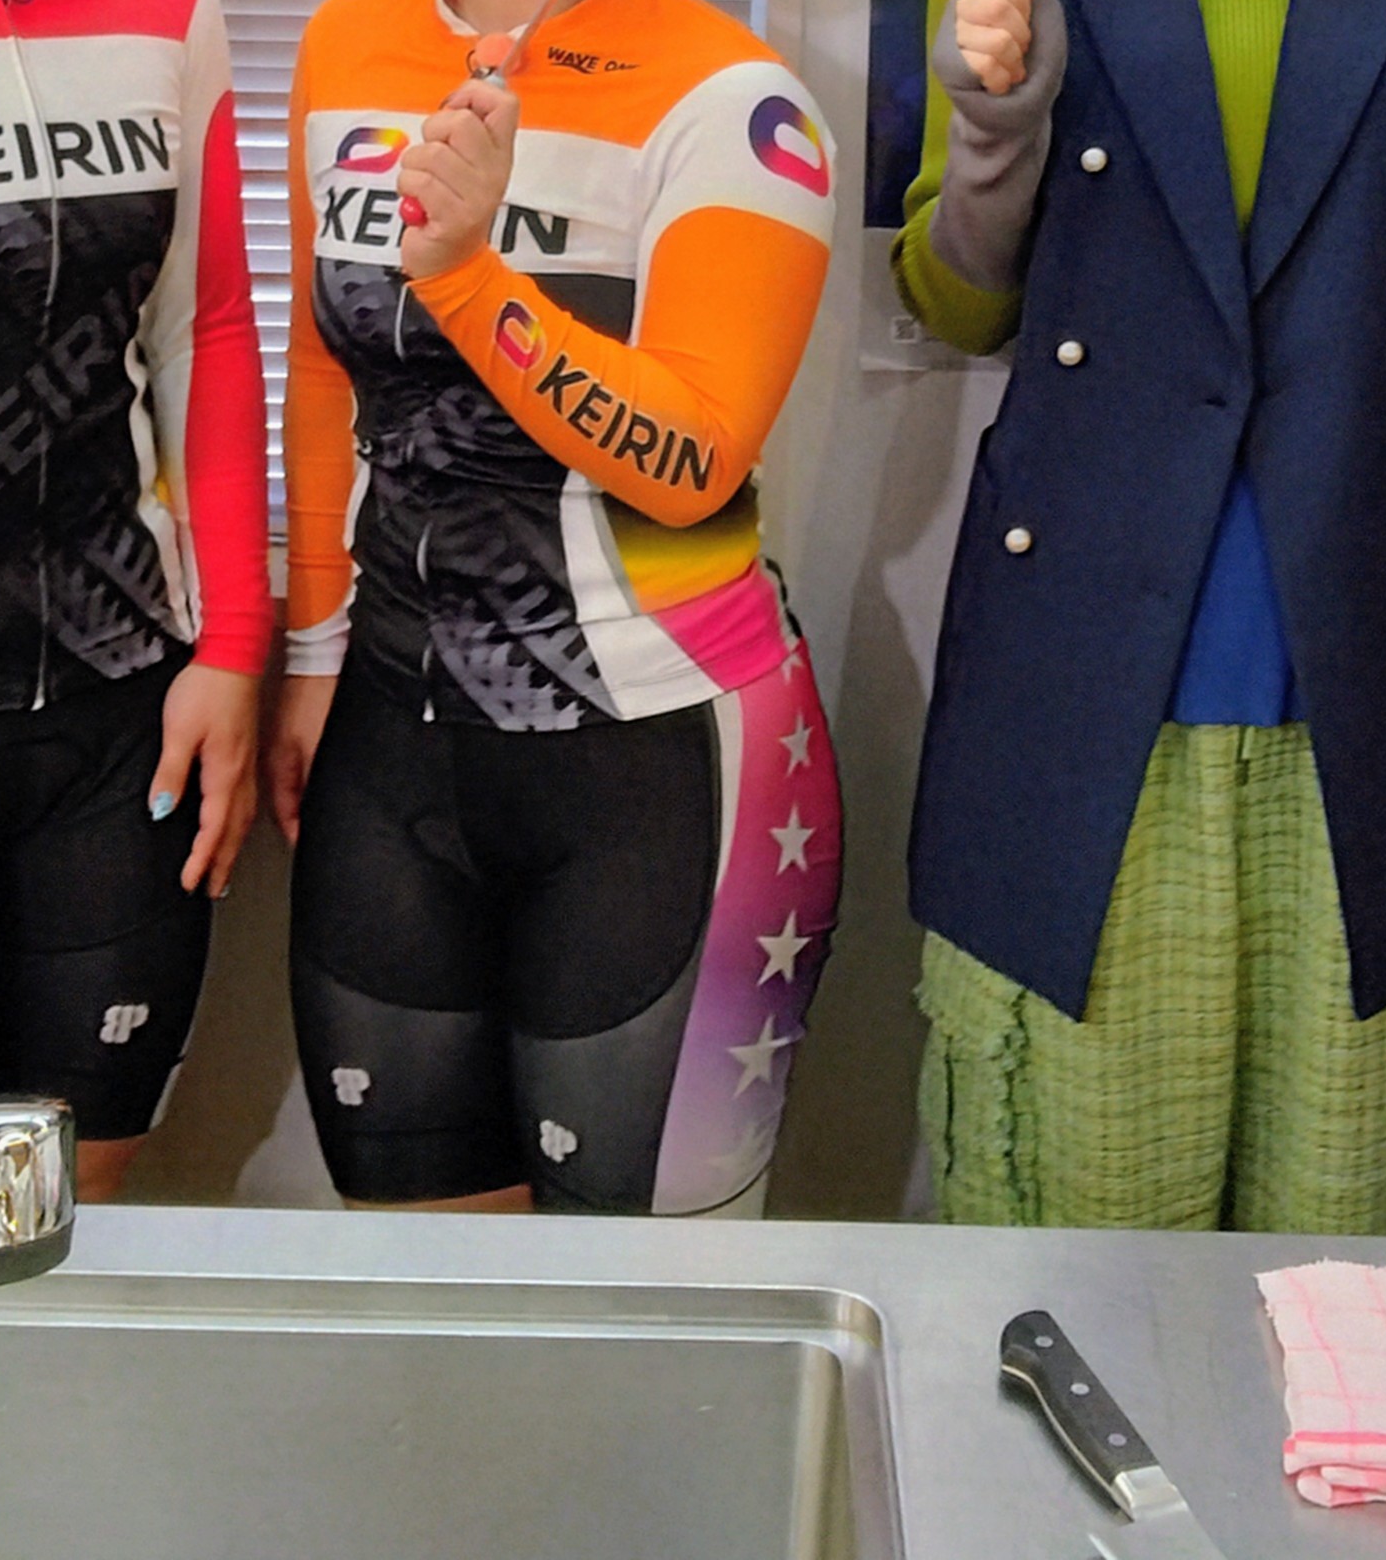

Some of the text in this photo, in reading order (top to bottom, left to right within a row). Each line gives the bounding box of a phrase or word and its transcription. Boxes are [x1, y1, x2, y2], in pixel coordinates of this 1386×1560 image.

[547, 46, 599, 71] WAVE
[319, 185, 569, 255] KEN
[534, 354, 716, 492] KEIRIN
